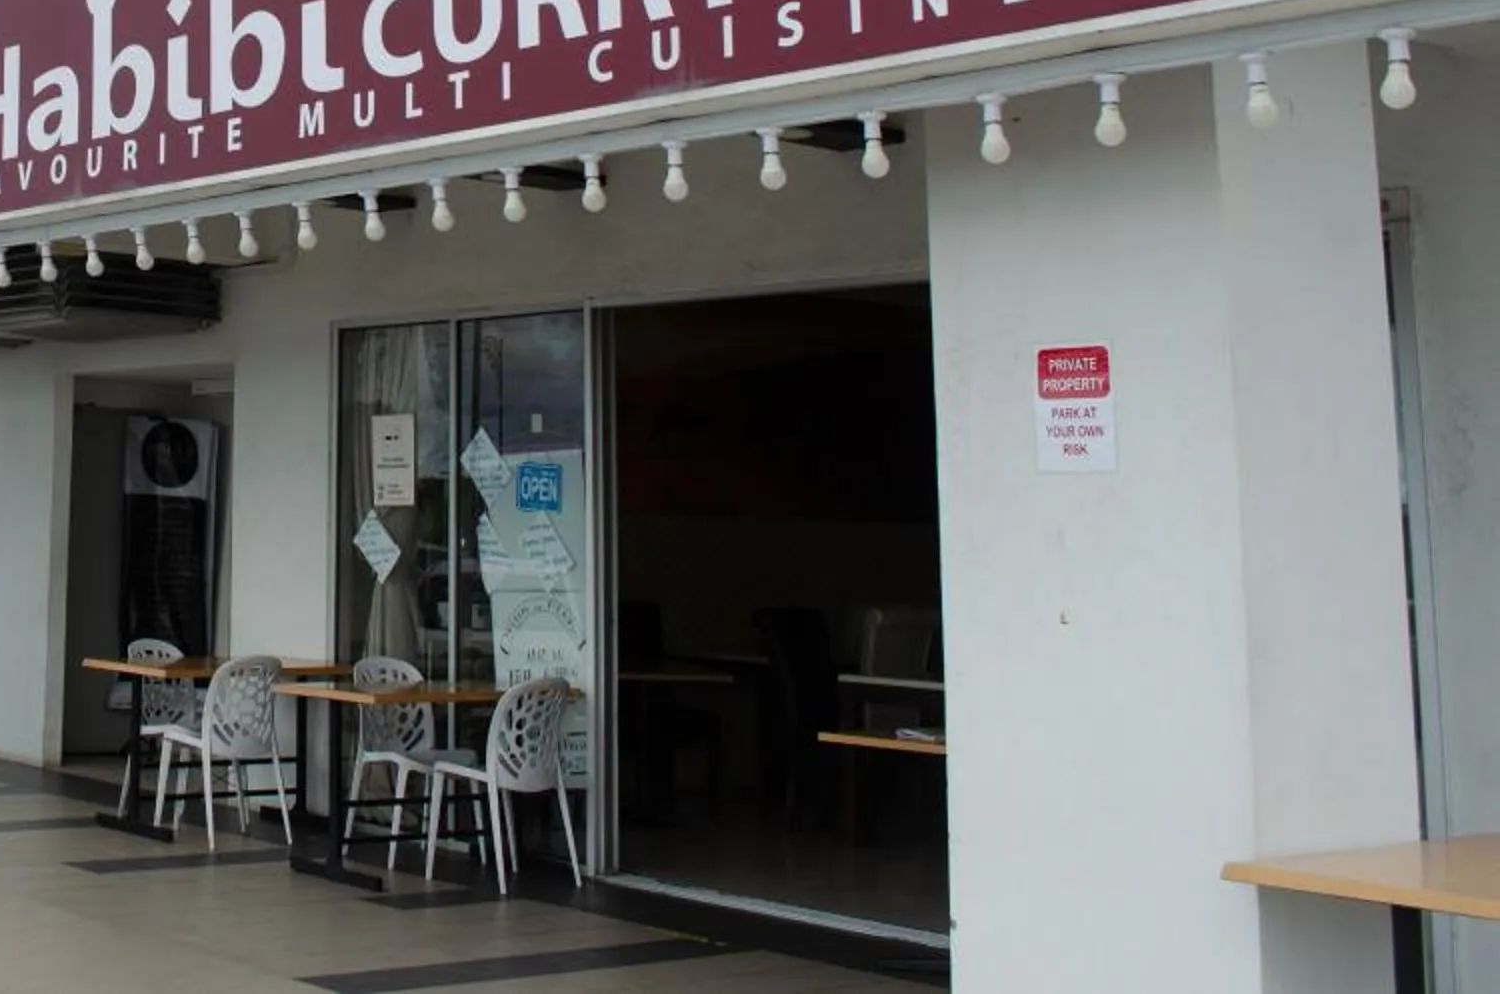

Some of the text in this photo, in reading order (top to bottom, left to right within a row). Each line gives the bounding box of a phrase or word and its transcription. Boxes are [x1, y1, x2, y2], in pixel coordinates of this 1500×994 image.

[298, 61, 512, 140] MULTI
[1048, 356, 1098, 372] PRIVATE
[1042, 376, 1106, 392] PROPERTY
[1050, 406, 1098, 420] PARK AT
[1045, 424, 1105, 438] YOUR OWN
[1062, 443, 1090, 456] RISK
[520, 475, 558, 503] OPEN
